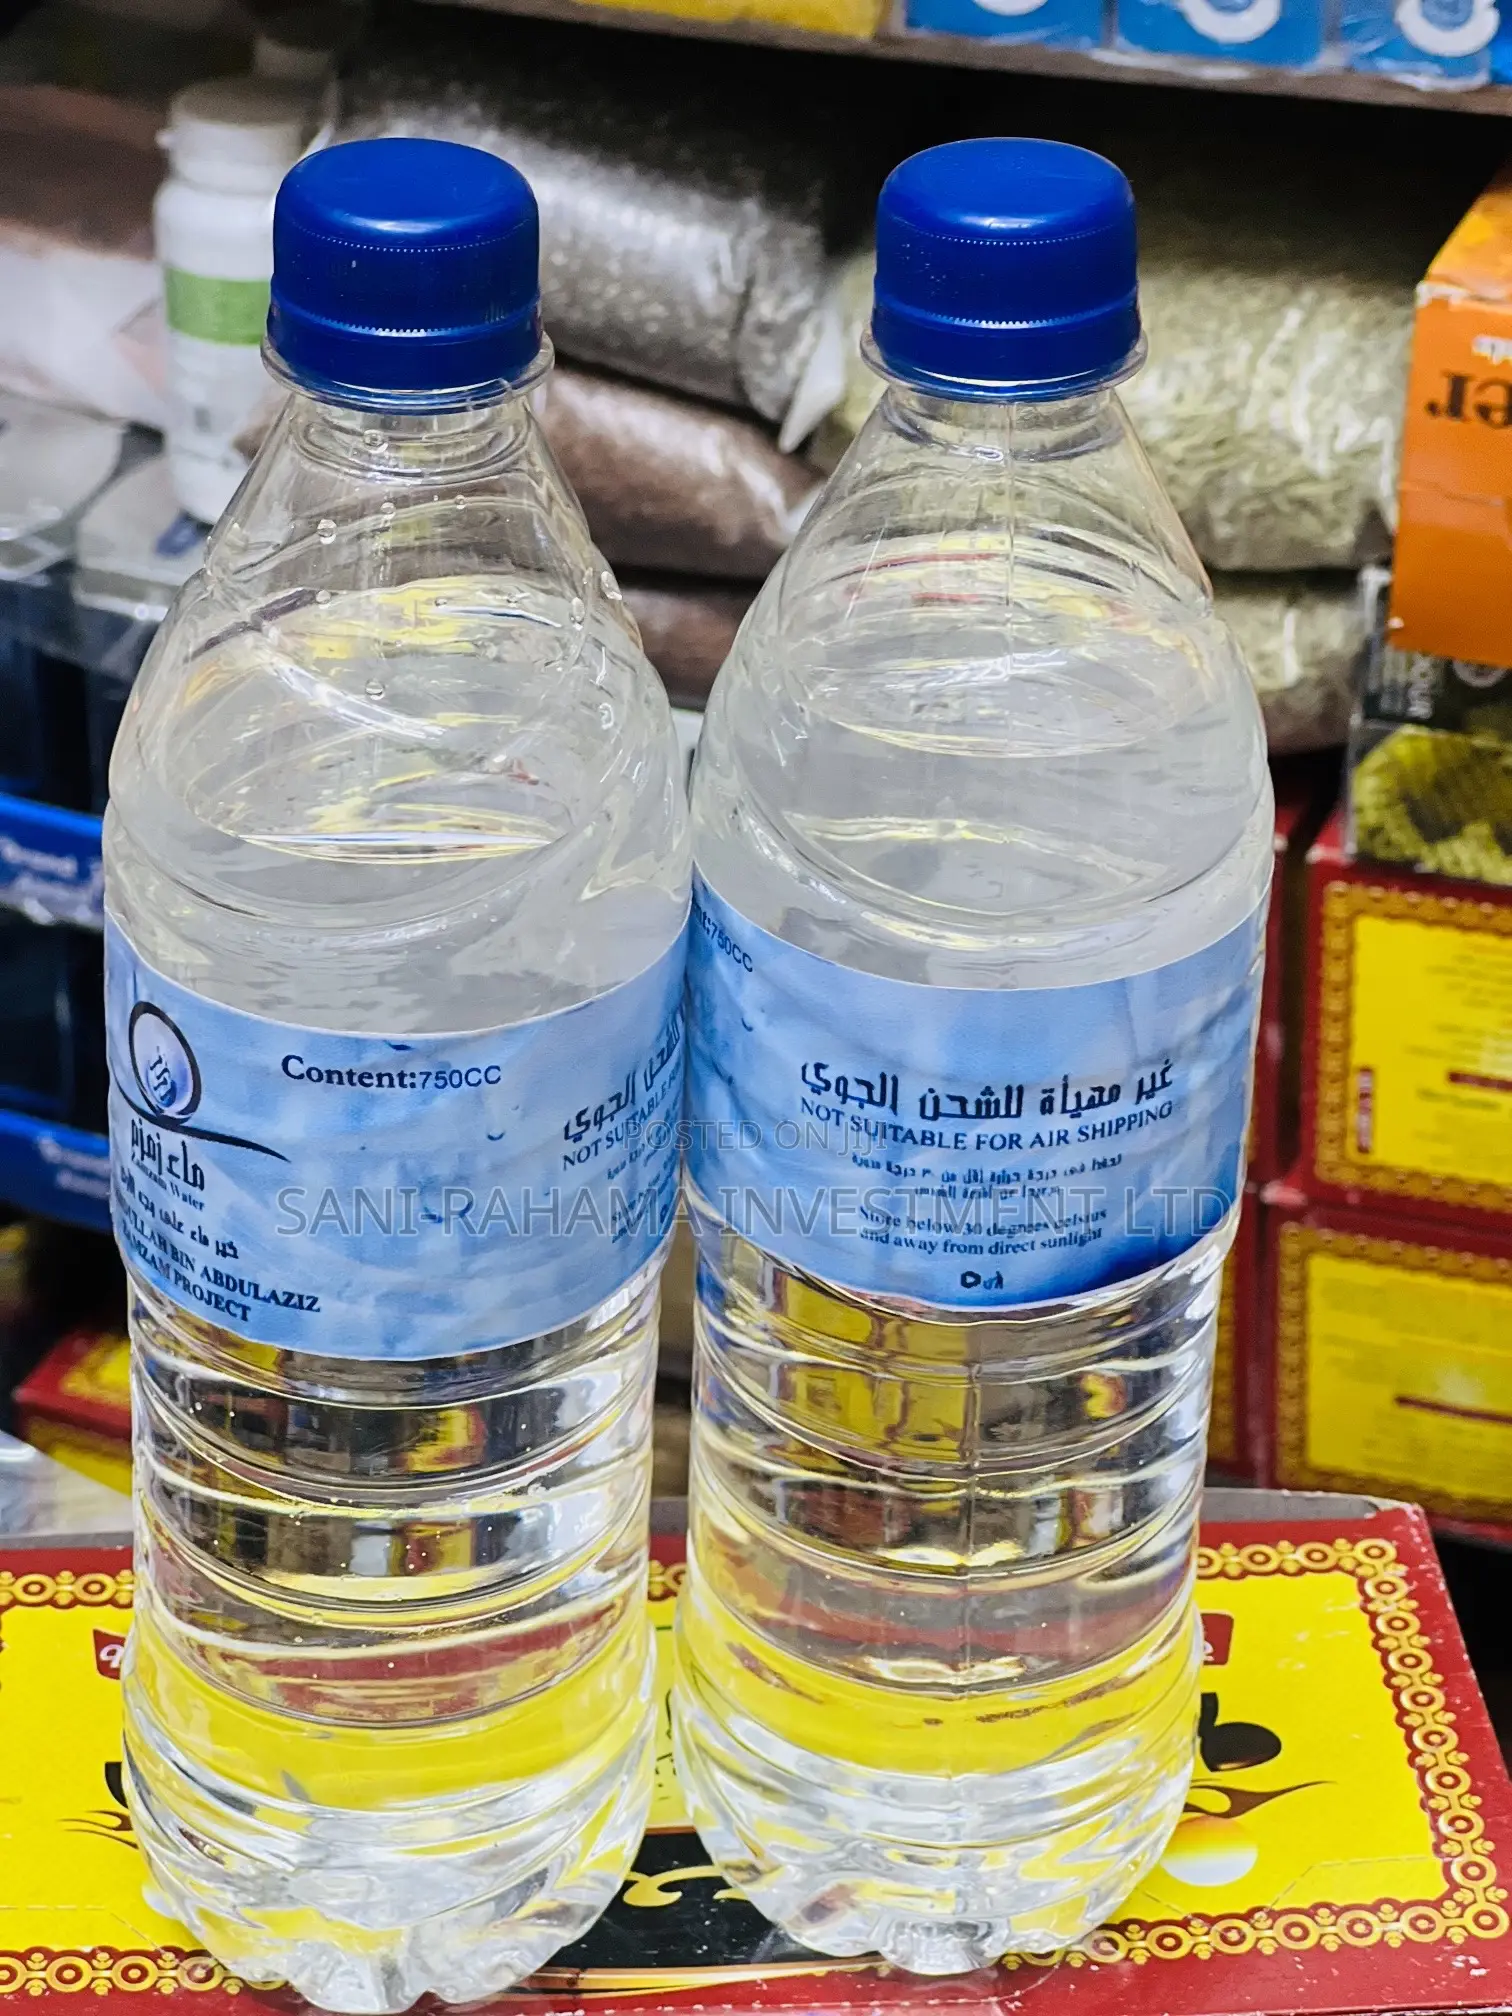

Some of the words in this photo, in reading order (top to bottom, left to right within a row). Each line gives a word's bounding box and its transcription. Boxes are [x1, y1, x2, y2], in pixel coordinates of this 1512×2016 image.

[1425, 369, 1512, 429] er
[281, 1054, 502, 1090] Content:750CC
[801, 1062, 900, 1117] الجوي
[1136, 1058, 1174, 1106] غير
[800, 1096, 845, 1127] NOT
[849, 1114, 967, 1151] SUITABLE
[975, 1133, 1023, 1152] FOR
[1029, 1127, 1070, 1147] AIR
[1076, 1099, 1174, 1144] SHIPPING
[918, 1084, 1025, 1121] للشحن
[562, 1135, 602, 1171] NOT
[859, 1205, 901, 1228] Store
[906, 1217, 956, 1234] below
[859, 1229, 890, 1246] and
[893, 1235, 938, 1255] away
[942, 1238, 984, 1256] from
[987, 1237, 1036, 1256] direct
[1039, 1227, 1103, 1249] sunlight
[169, 1242, 196, 1274] BIN
[199, 1265, 321, 1313] ABDULAZIZ
[172, 1267, 252, 1322] PROJECT
